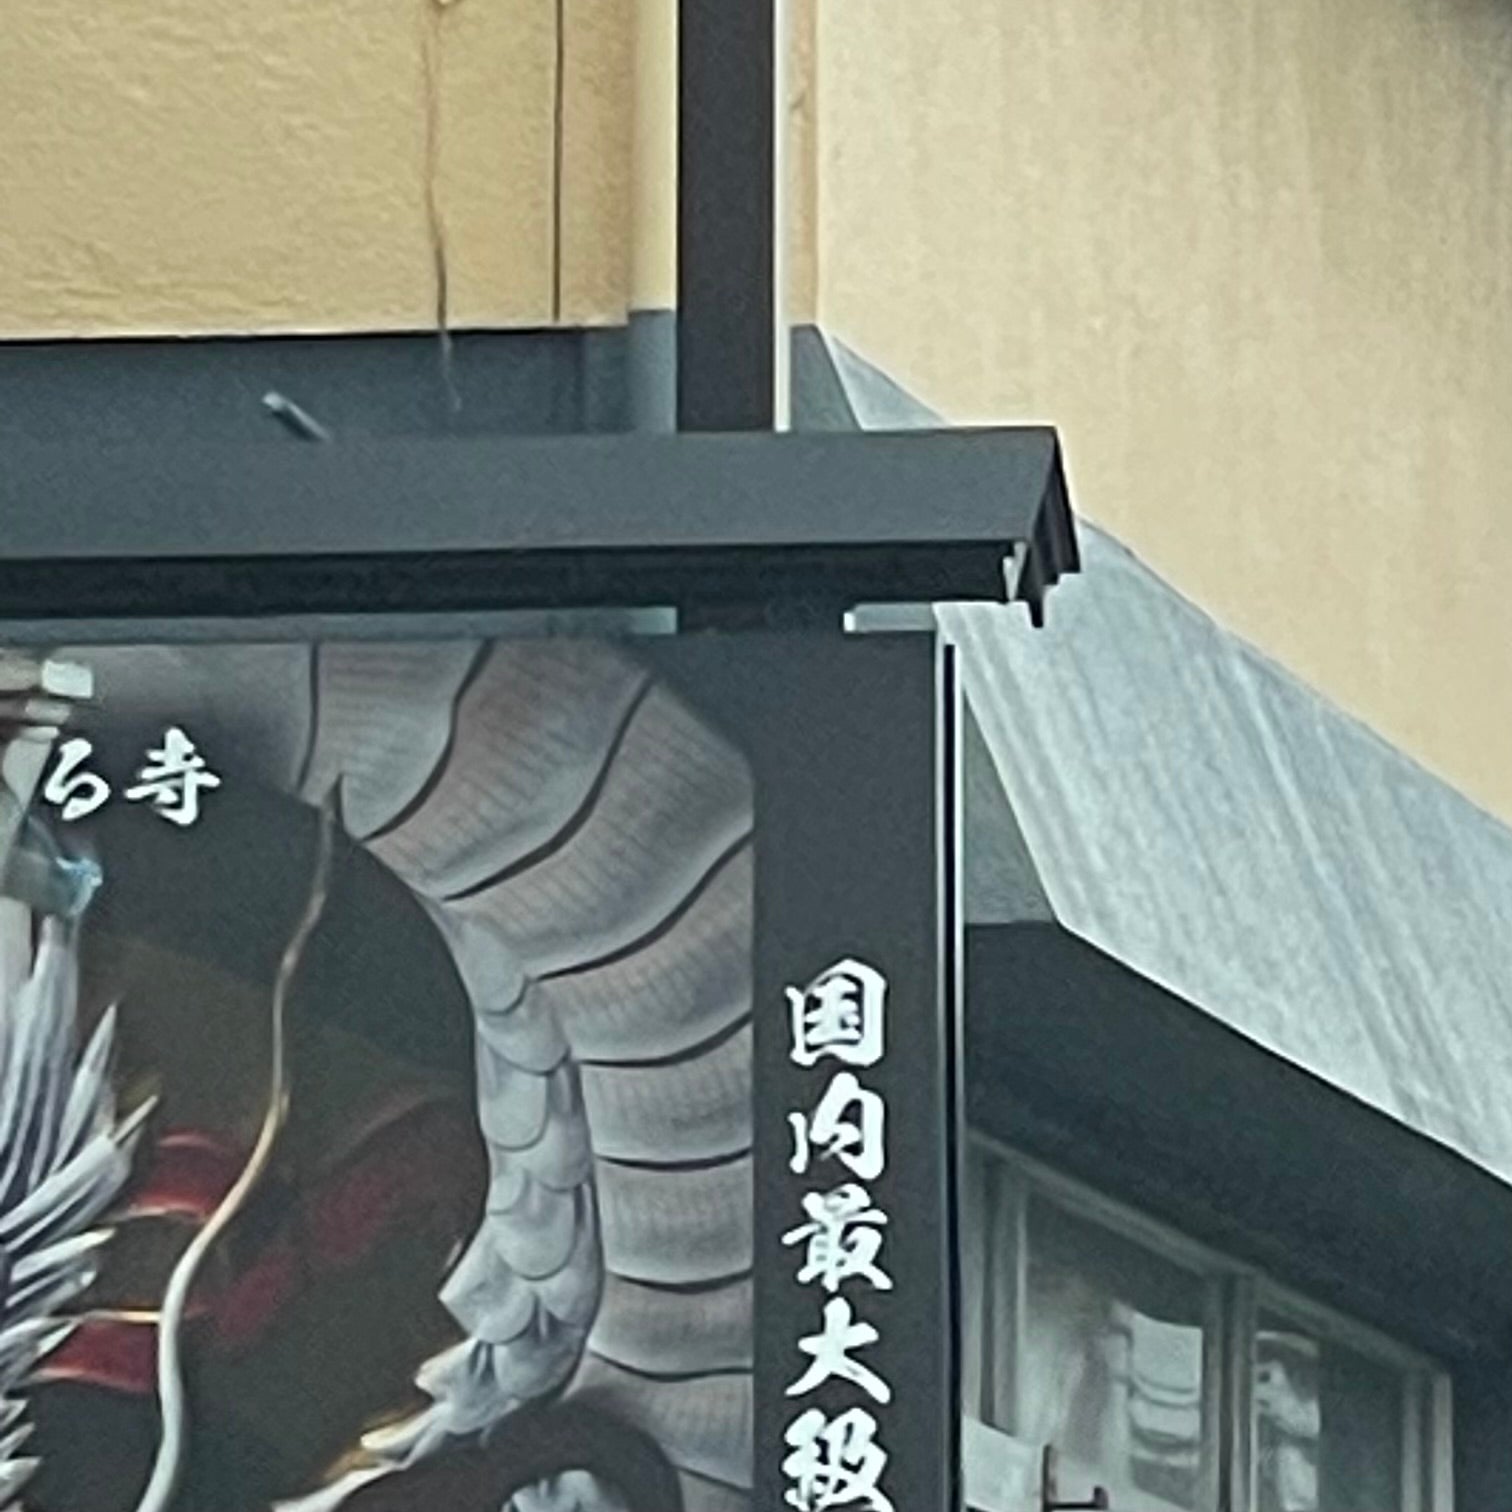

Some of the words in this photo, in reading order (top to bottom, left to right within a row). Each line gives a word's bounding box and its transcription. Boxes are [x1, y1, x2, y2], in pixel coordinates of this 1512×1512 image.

[781, 958, 895, 1512] 国内最大級
